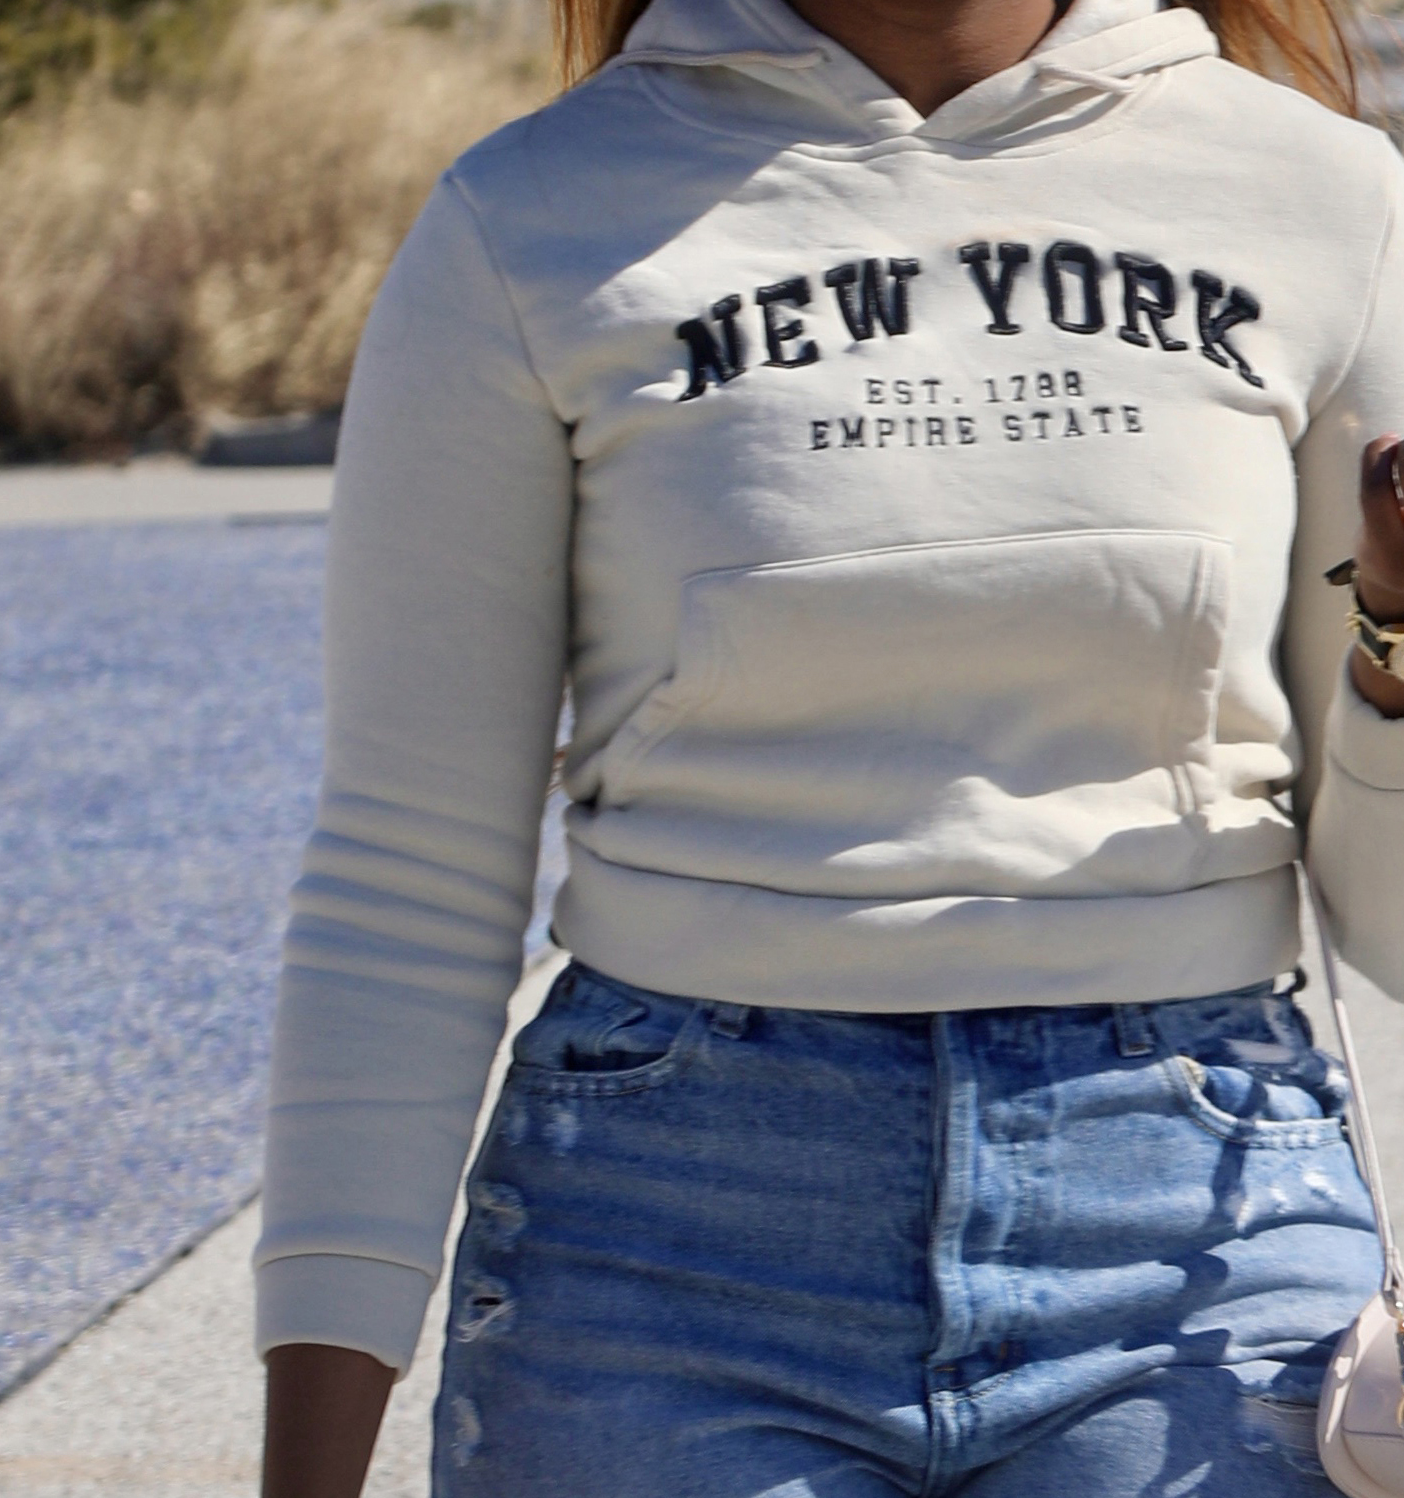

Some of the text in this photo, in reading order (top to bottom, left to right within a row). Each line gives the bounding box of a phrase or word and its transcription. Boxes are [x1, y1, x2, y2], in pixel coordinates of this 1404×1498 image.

[675, 241, 1265, 400] NEW YORK
[865, 370, 1084, 406] EST. 1788
[809, 406, 1144, 450] EMPIRE STATE
